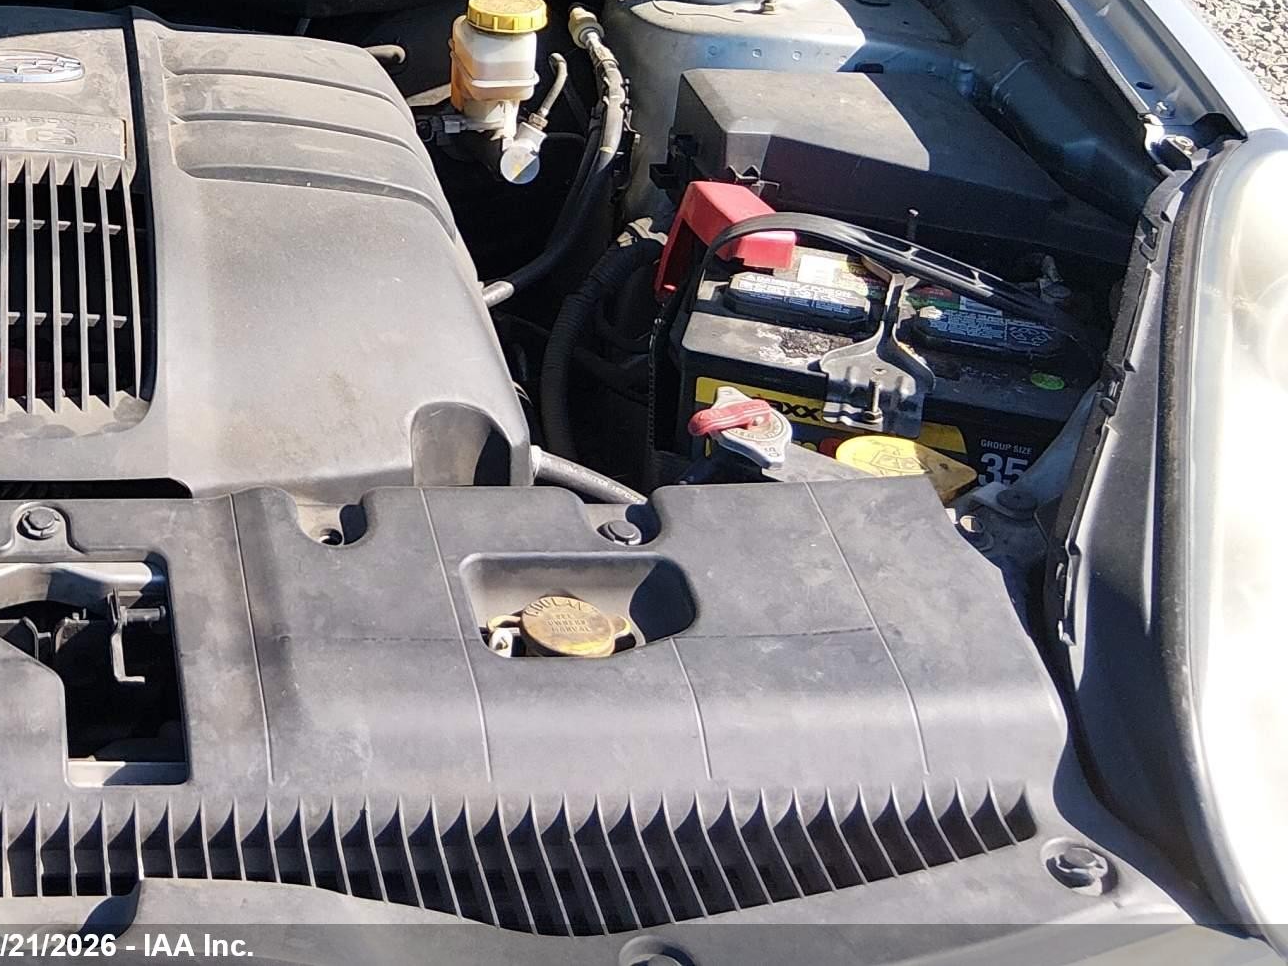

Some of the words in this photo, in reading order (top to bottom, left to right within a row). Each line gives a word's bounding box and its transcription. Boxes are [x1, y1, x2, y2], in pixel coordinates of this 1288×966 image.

[980, 439, 1012, 451] GROUP
[1013, 445, 1032, 455] SIZE
[978, 452, 1029, 487] 35
